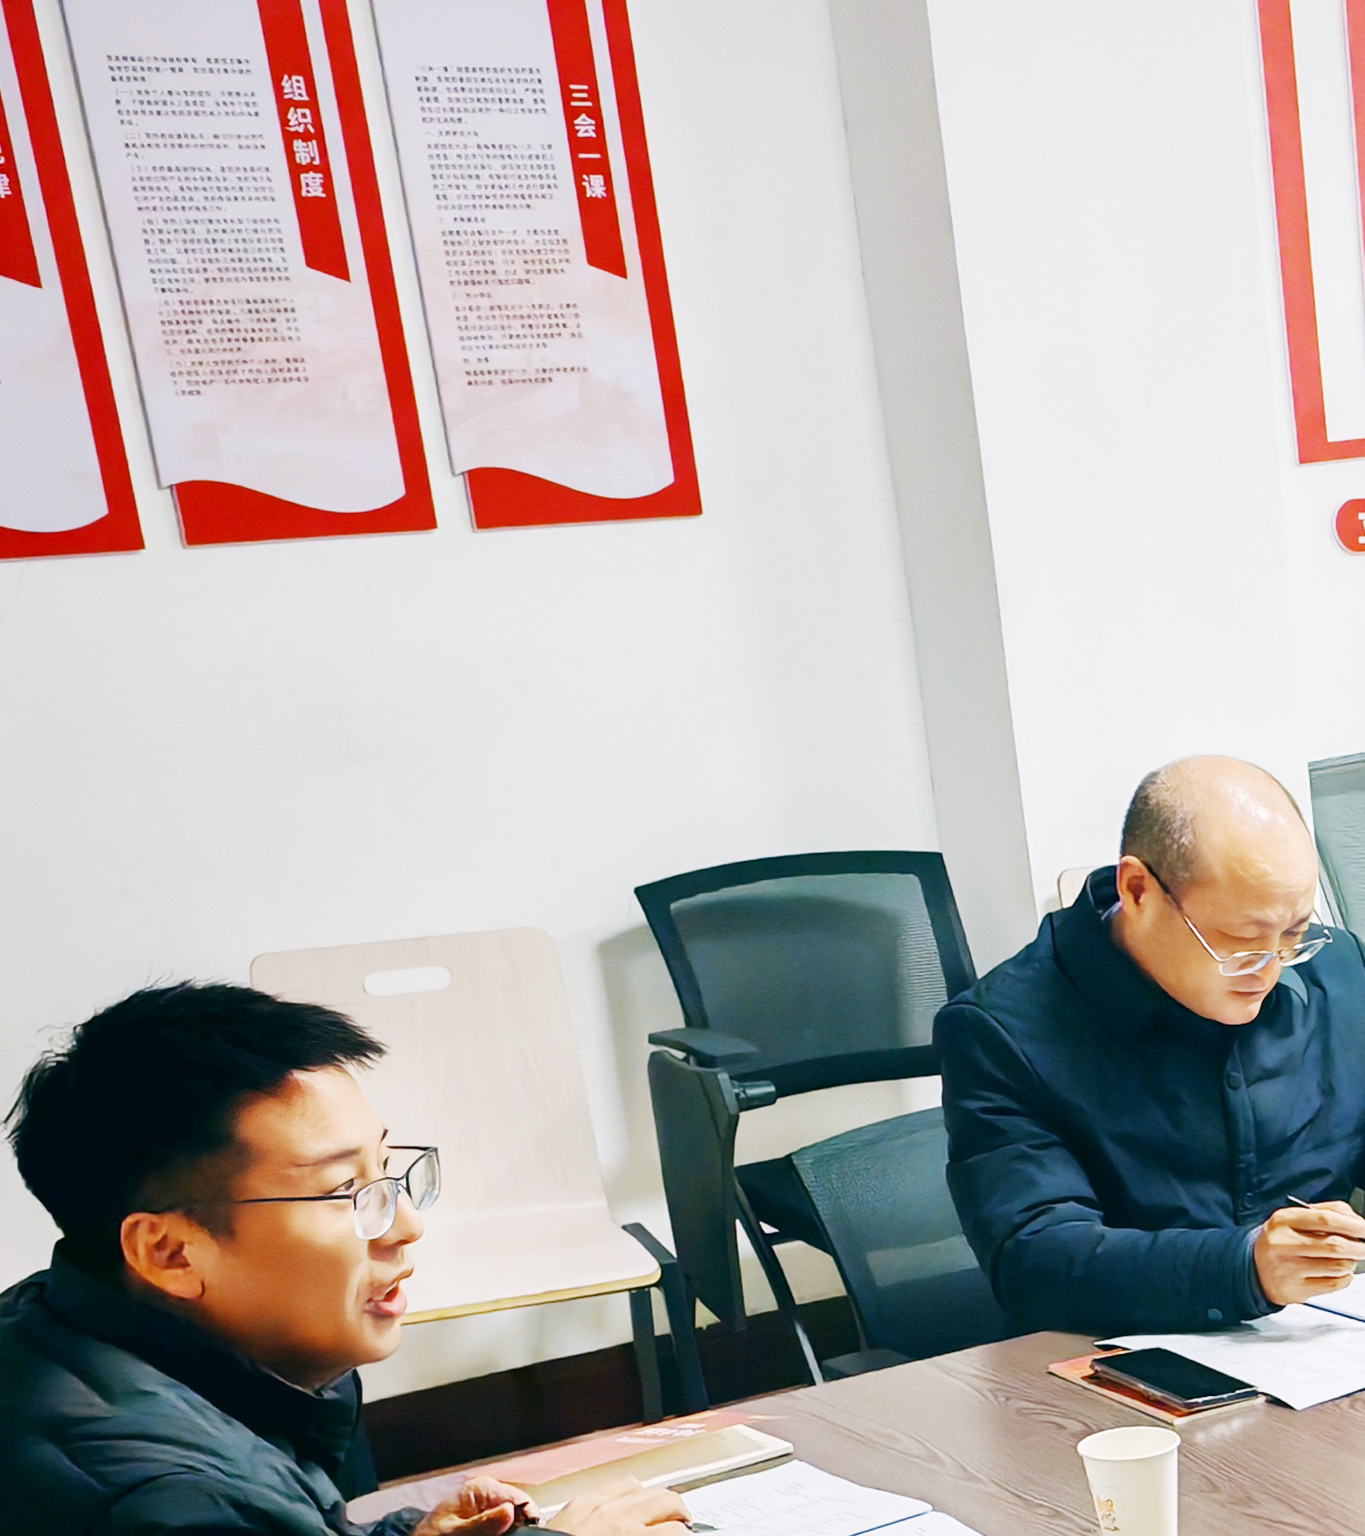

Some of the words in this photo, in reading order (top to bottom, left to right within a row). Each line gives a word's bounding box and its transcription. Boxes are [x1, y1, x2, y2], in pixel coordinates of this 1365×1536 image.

[281, 74, 327, 198] 组织制度
[569, 84, 607, 199] 三会一课
